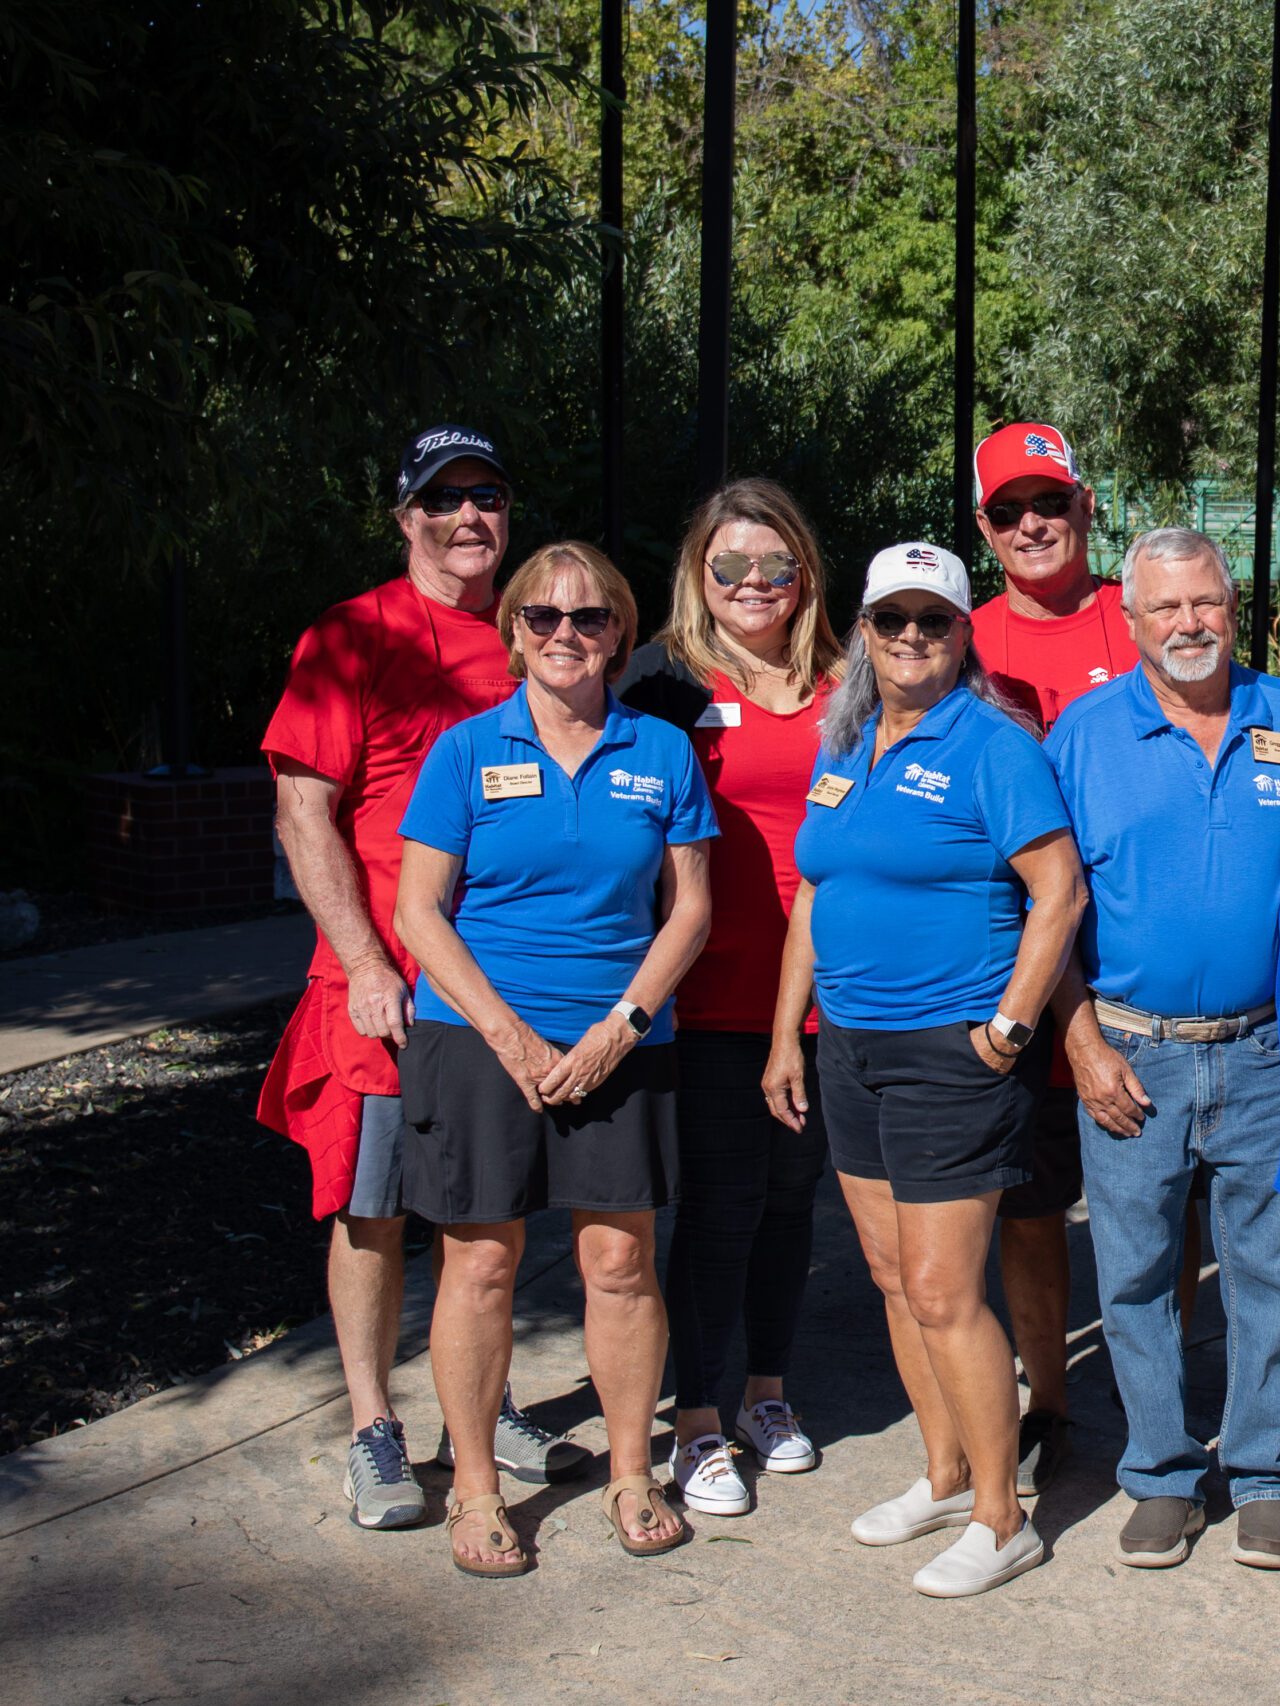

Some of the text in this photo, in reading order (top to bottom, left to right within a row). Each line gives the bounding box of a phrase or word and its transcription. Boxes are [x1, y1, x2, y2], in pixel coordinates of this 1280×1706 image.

[414, 430, 494, 462] Titleist
[633, 775, 664, 787] Habitat
[923, 770, 951, 784] Habitat
[610, 790, 645, 801] Veterans
[925, 791, 945, 804] Build
